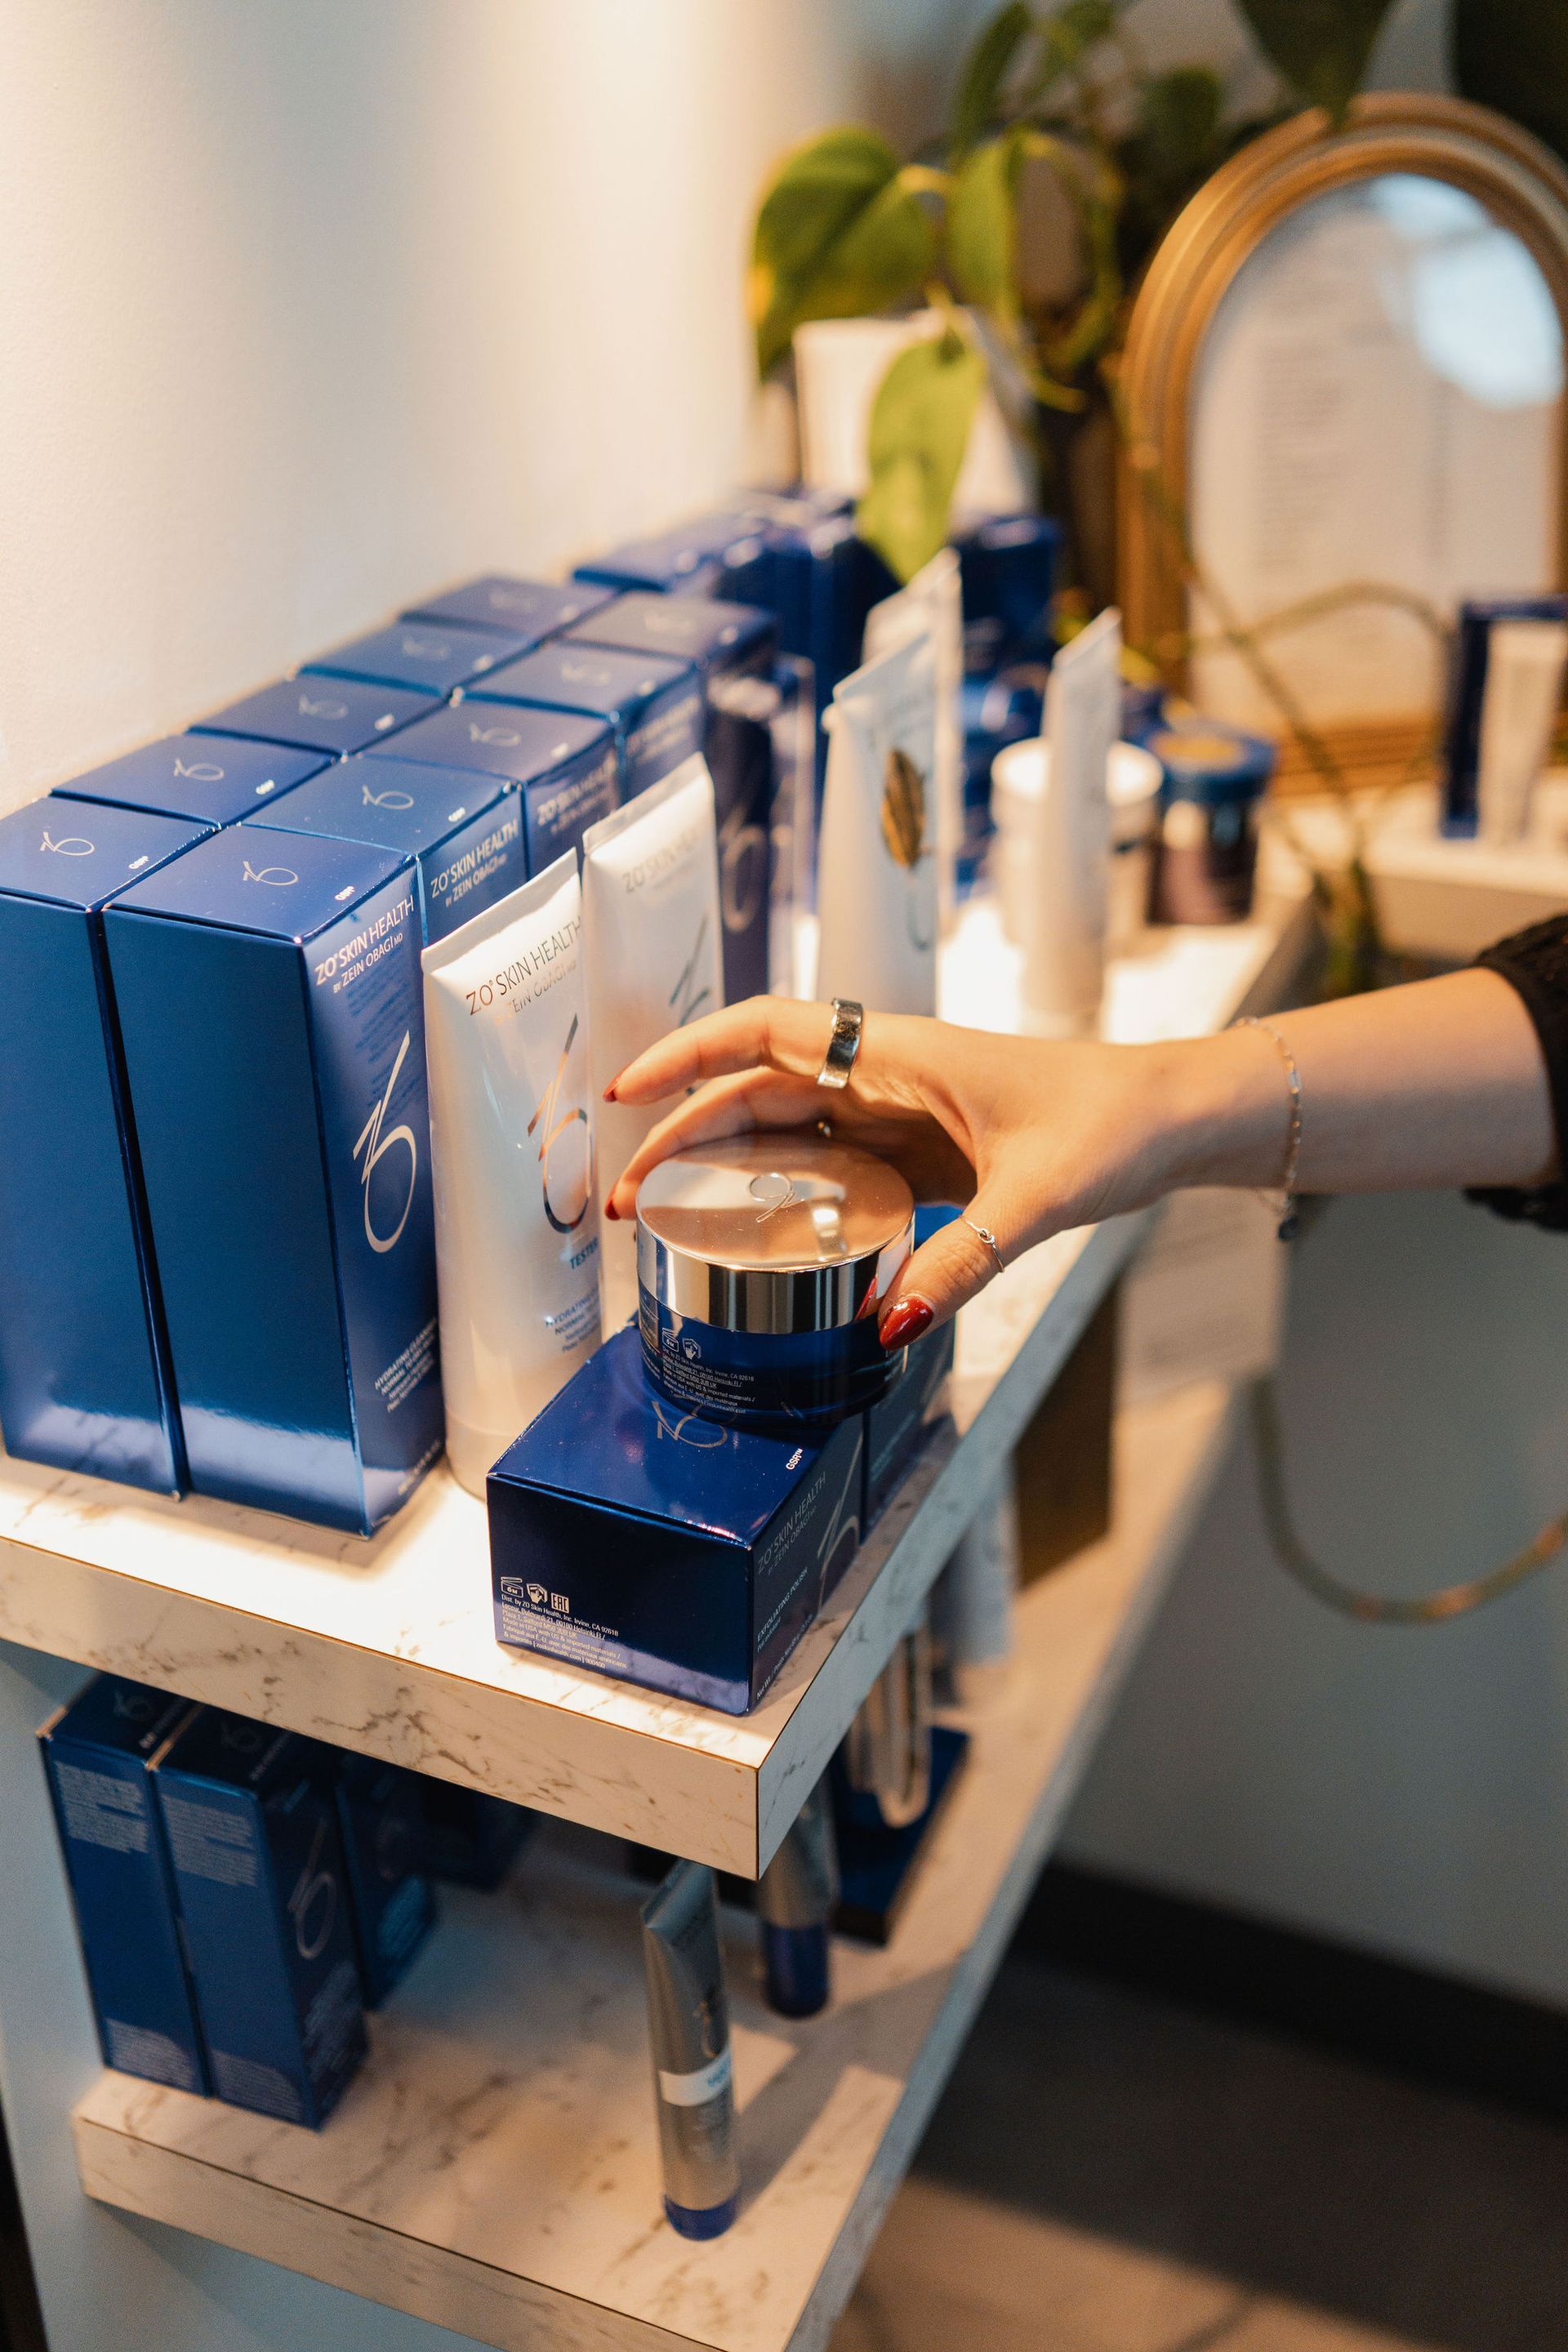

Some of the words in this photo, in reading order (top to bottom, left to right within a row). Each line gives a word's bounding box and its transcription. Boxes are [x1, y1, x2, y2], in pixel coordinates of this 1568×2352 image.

[450, 849, 475, 883] SKIN
[476, 817, 519, 863] HEALTH
[338, 932, 368, 968] SKIN
[368, 894, 414, 944] HEALTH
[496, 956, 532, 996] SKIN
[530, 915, 581, 970] HEALTH
[341, 960, 364, 987] ZEIN
[365, 936, 394, 967] OBAGI
[773, 1517, 793, 1552] SKIN
[795, 1471, 826, 1524] HEALTH
[501, 1594, 513, 1603] Dist.
[514, 1598, 521, 1606] by
[530, 1602, 542, 1612] Skin
[564, 1613, 573, 1621] Inc.
[592, 1623, 600, 1632] CA
[601, 1627, 618, 1637] 92618
[525, 1624, 538, 1634] USA
[757, 1592, 790, 1643] EXFOLIATING
